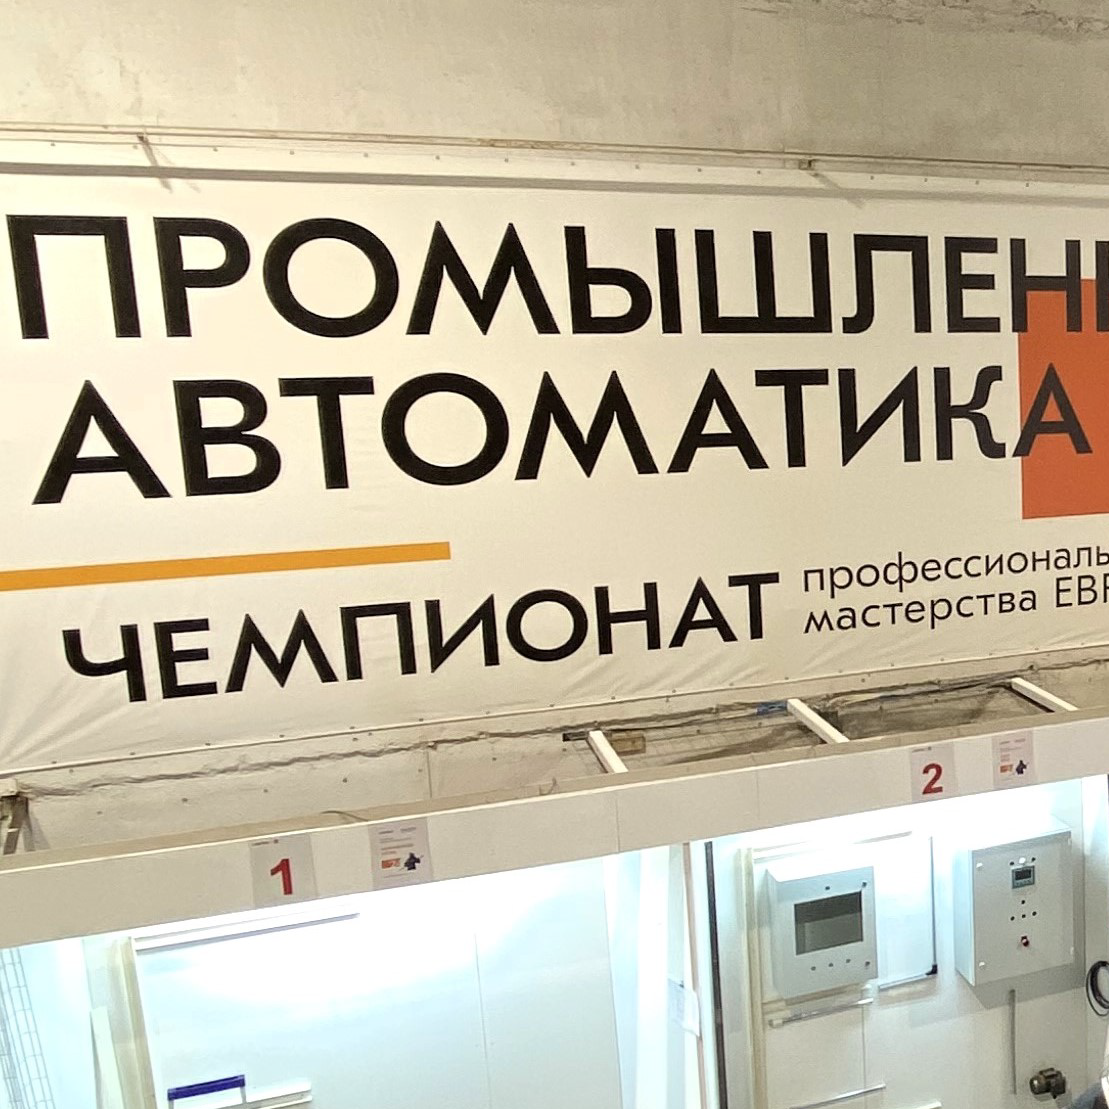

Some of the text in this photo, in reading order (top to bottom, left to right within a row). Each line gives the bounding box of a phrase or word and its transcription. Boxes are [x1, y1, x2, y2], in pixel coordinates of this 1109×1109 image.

[32, 363, 1093, 504] АВТОМАТИКА
[803, 589, 1038, 634] мастерства
[62, 572, 779, 702] ЧЕМПИОНАТ
[922, 763, 943, 795] 2
[270, 858, 293, 896] 1
